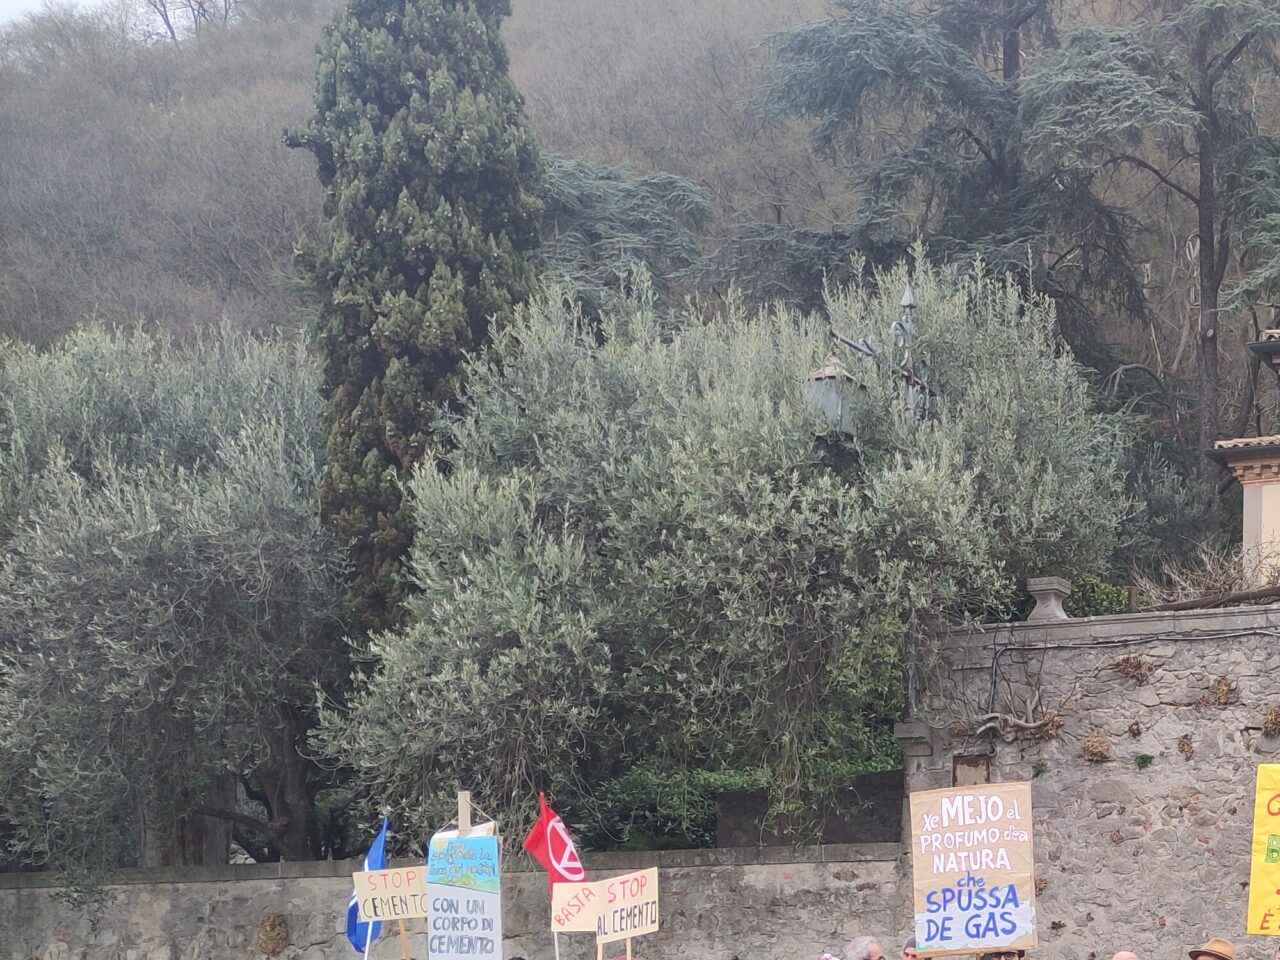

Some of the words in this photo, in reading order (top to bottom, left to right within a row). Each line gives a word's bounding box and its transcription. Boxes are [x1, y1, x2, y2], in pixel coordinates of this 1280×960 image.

[942, 794, 1003, 828] MEJO
[1007, 800, 1022, 820] el
[920, 828, 1000, 854] PROFUMO
[933, 848, 1011, 874] NATURA
[368, 871, 417, 891] STOP
[608, 875, 647, 904] STOP
[957, 871, 985, 888] che
[433, 898, 459, 914] CON
[466, 899, 485, 914] UN
[554, 887, 596, 926] BASTA
[926, 884, 1019, 914] SPUSSA
[433, 917, 478, 932] CORPO
[482, 918, 494, 932] DI
[597, 914, 608, 936] AL
[612, 900, 657, 933] CEMENTO
[925, 917, 953, 942] DE
[965, 912, 1017, 939] GAS
[430, 935, 495, 954] CEMENTO
